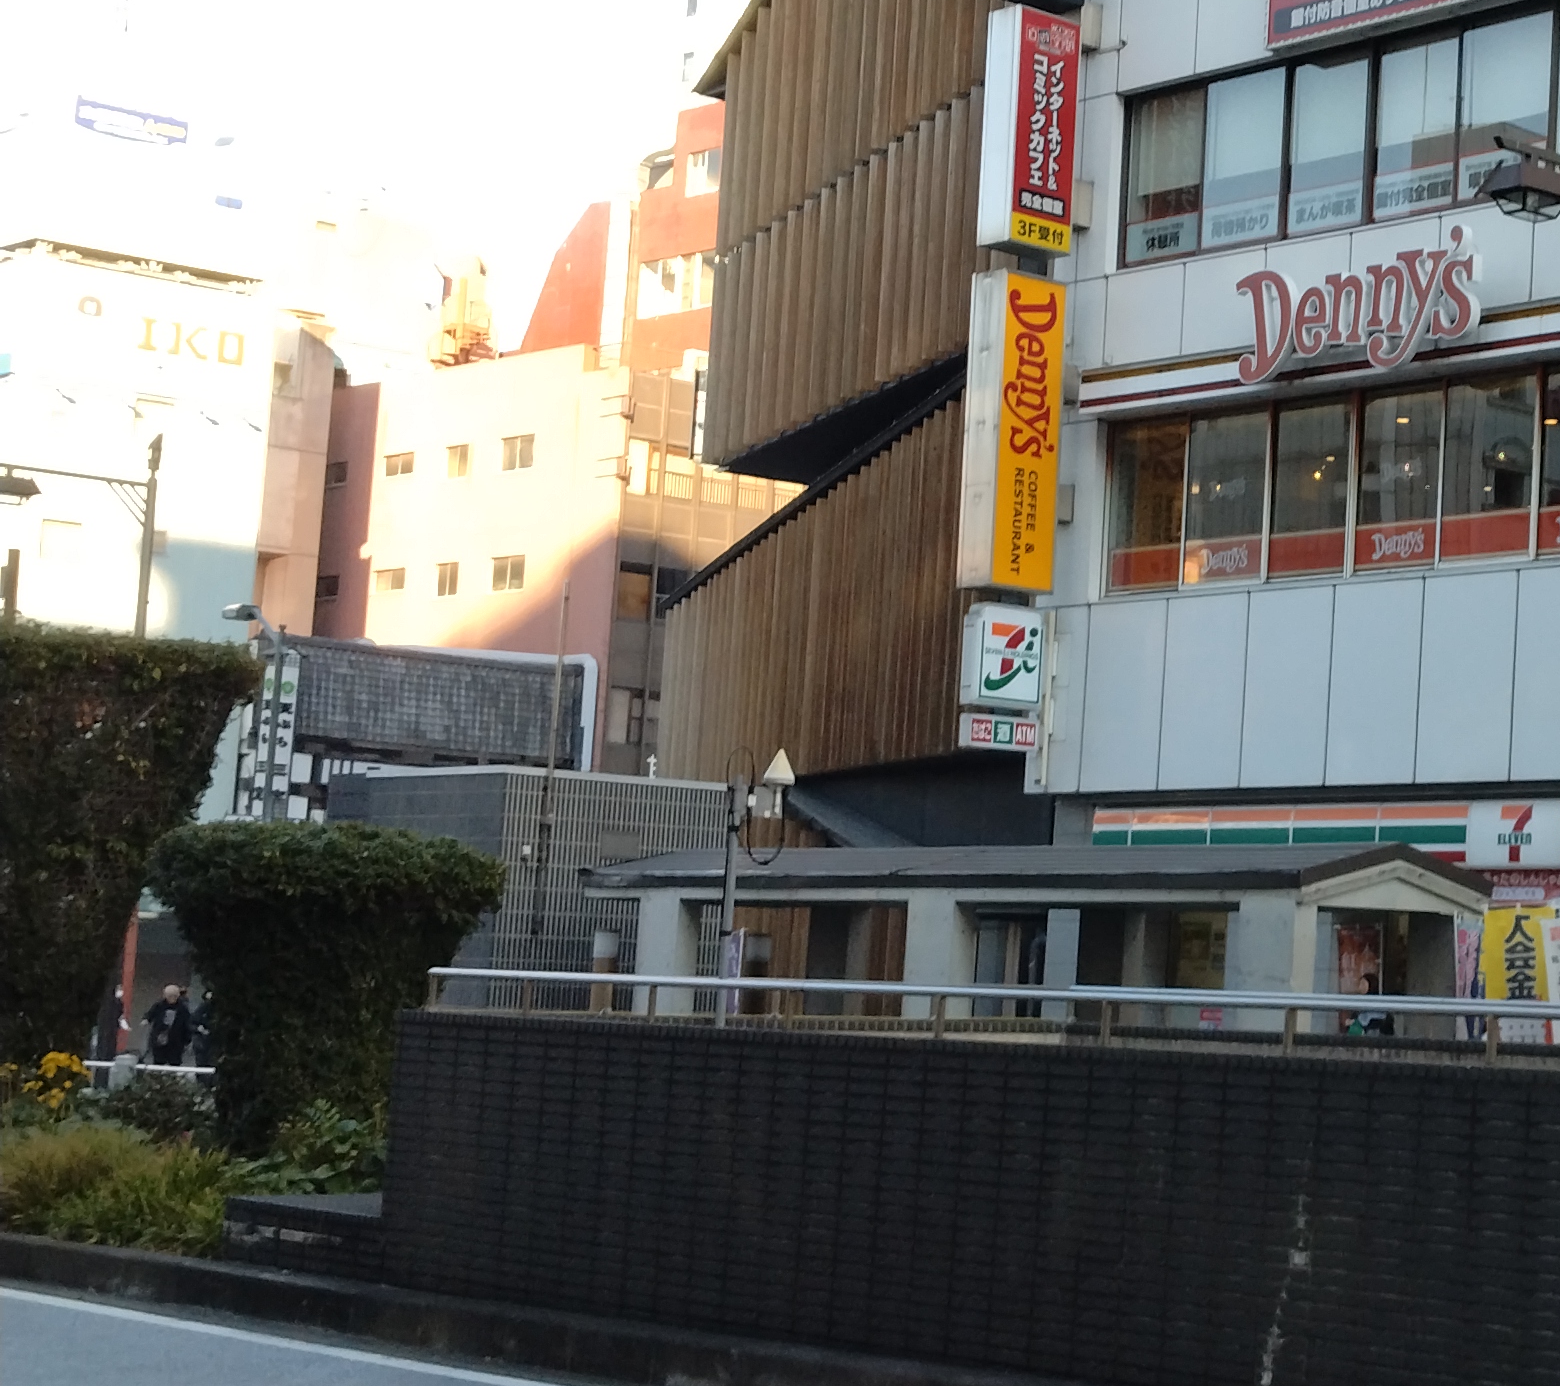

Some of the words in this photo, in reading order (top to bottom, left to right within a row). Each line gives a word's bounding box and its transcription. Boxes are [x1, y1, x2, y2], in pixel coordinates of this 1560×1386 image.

[1029, 53, 1049, 187] コミックカフェ
[1018, 219, 1064, 245] 3F受付
[1236, 225, 1478, 385] Denny's
[1004, 289, 1057, 460] Denny's
[1010, 467, 1025, 576] RESTAURANT
[1026, 470, 1038, 532] COFFEE
[1200, 543, 1248, 574] Denny's
[1371, 527, 1425, 561] Denny's
[1015, 725, 1035, 744] ATM
